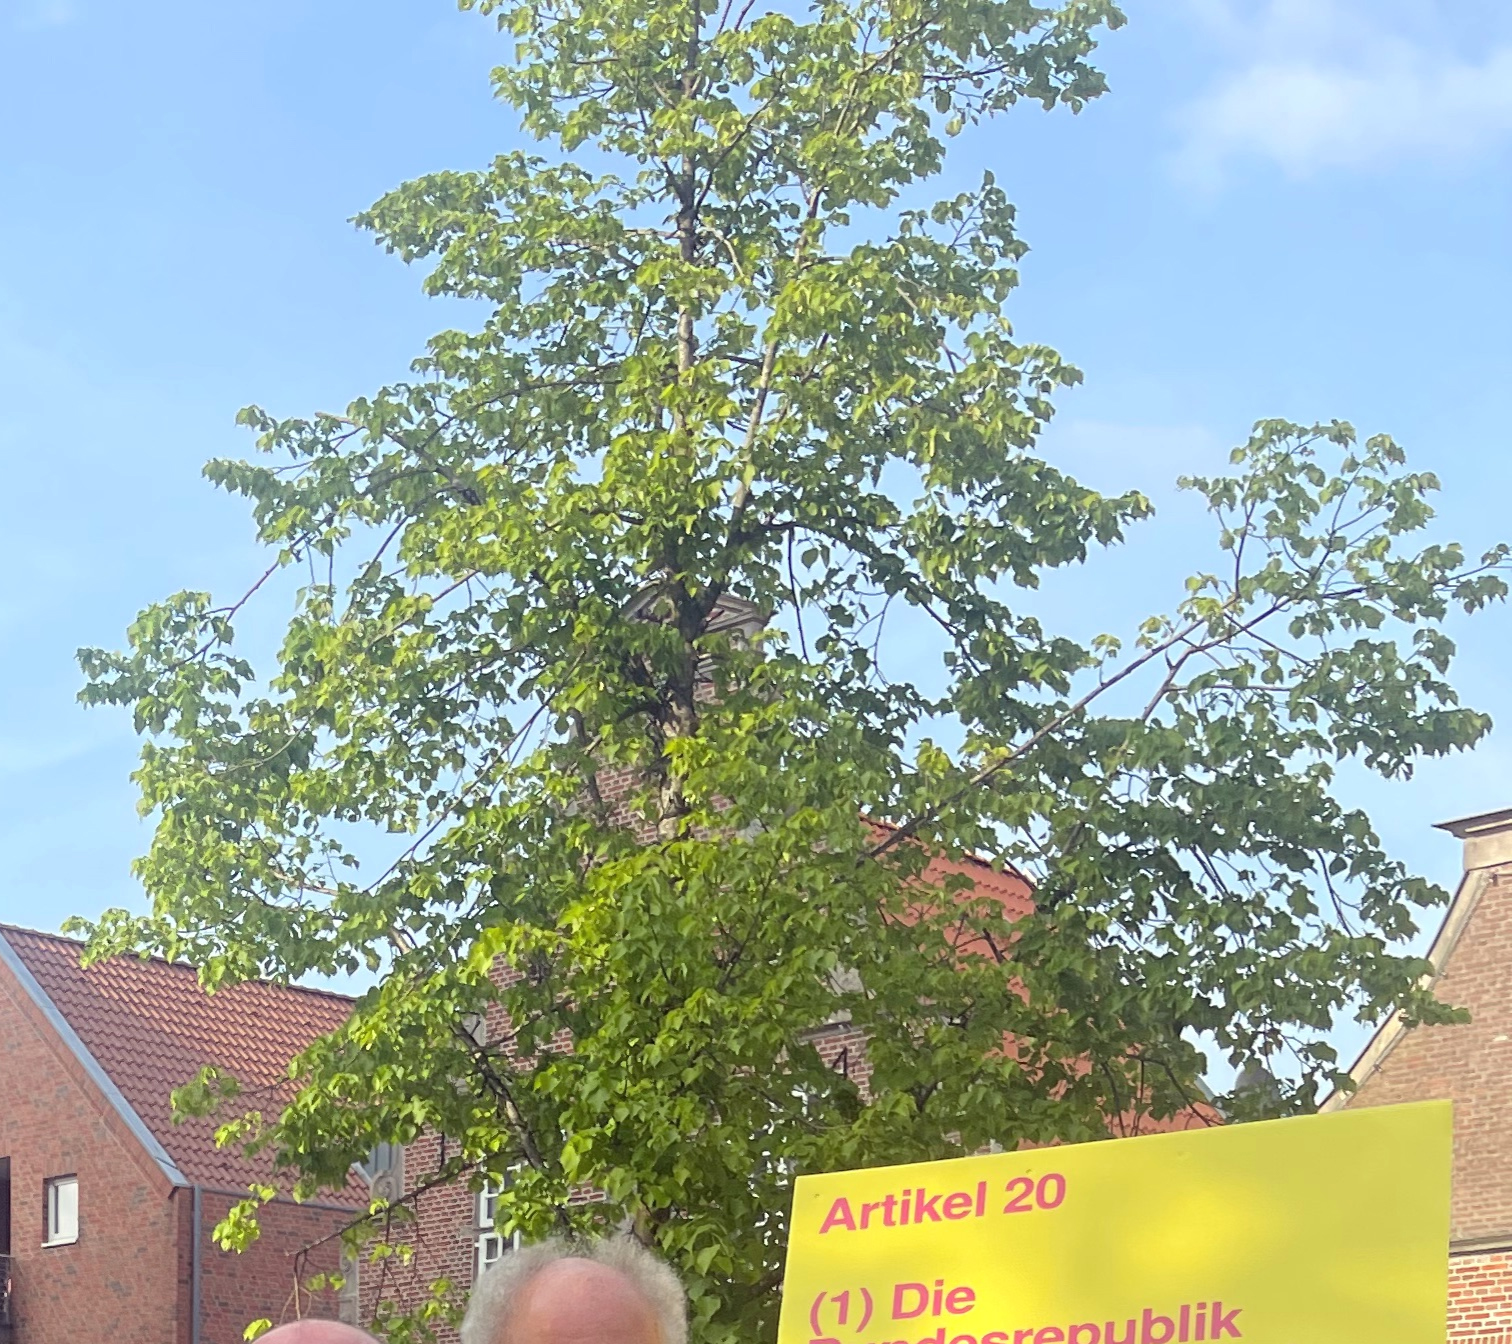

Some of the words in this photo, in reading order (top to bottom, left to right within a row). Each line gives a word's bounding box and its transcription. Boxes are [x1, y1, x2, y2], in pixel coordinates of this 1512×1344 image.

[820, 1181, 987, 1234] Artikel
[1004, 1173, 1066, 1213] 20
[809, 1286, 875, 1338] (1)
[891, 1280, 975, 1320] Die
